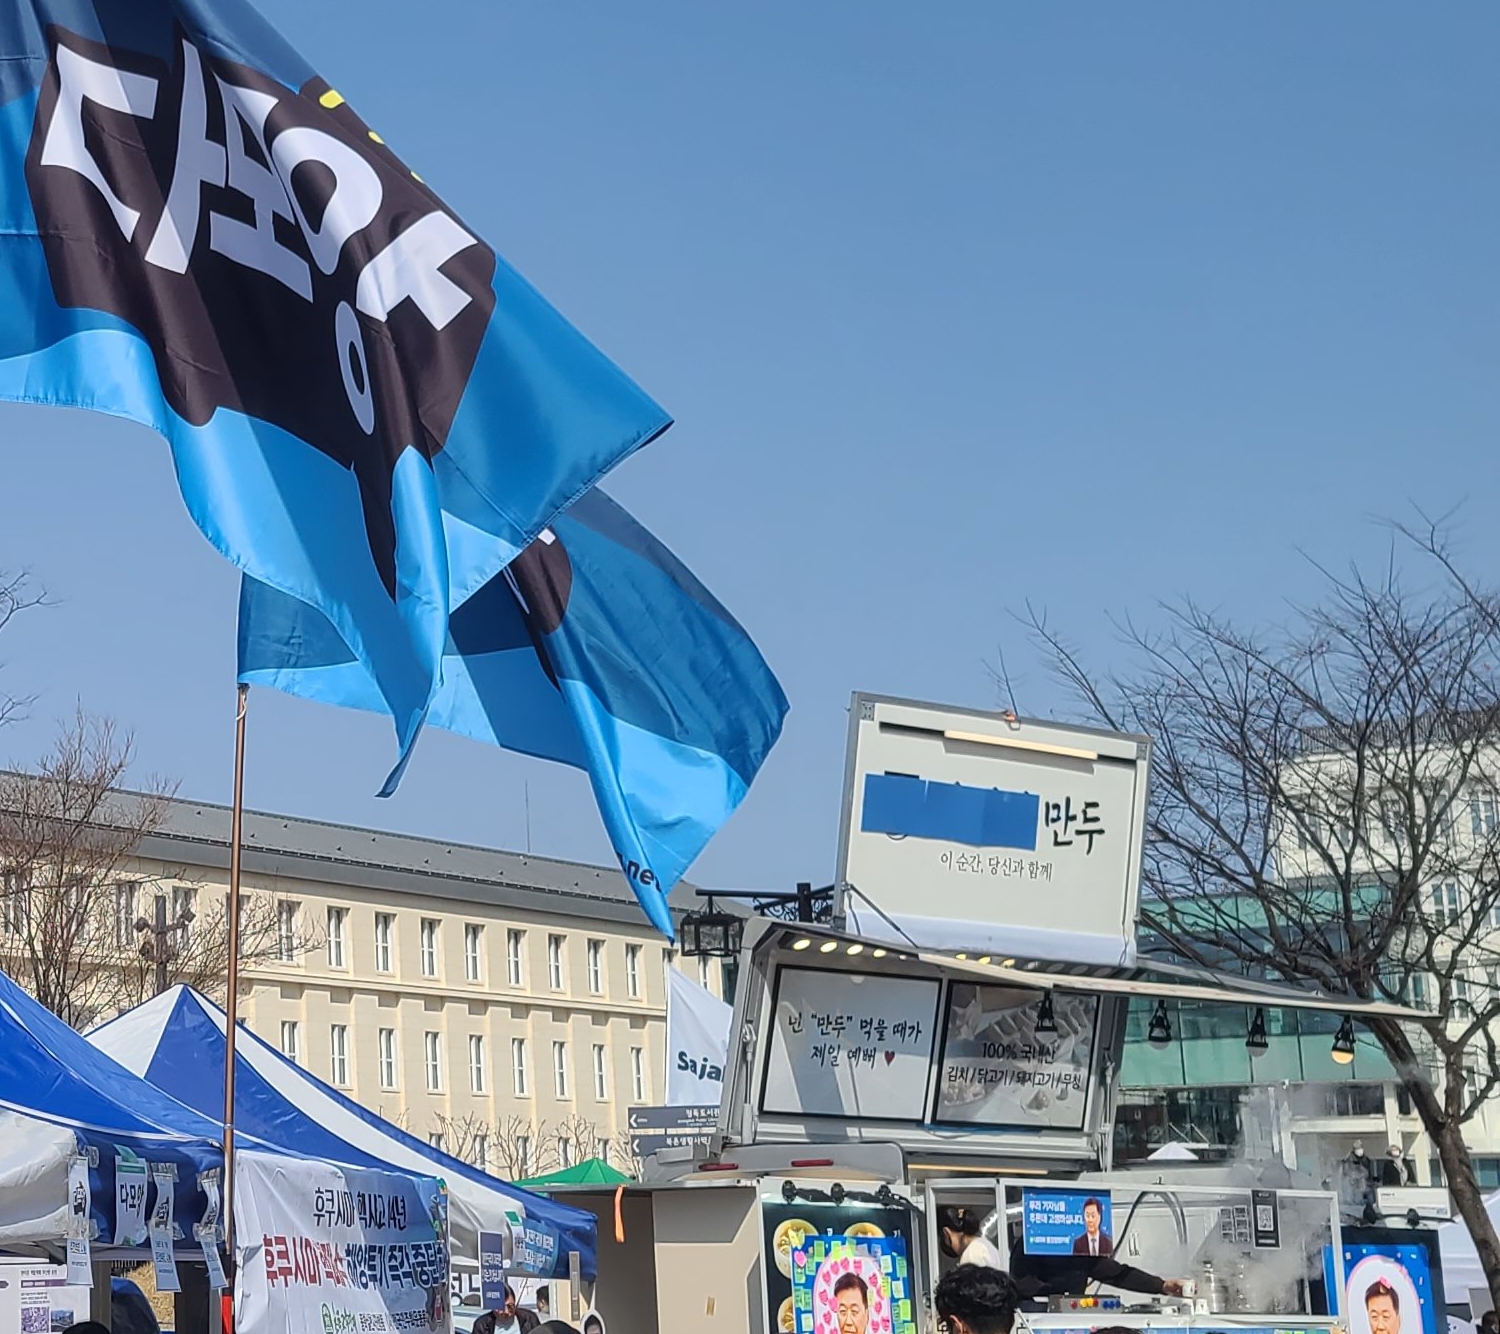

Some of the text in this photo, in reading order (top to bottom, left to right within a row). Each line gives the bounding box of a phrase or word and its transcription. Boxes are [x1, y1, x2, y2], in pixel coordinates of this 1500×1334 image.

[40, 37, 478, 436] 다모앙
[1044, 796, 1105, 855] 만두
[940, 851, 1053, 882] 이 순간, 당신과 함께
[859, 1017, 888, 1041] 먹을
[892, 1020, 922, 1044] 때가
[677, 1050, 725, 1083] Saja
[810, 1042, 877, 1070] 제일 예뻐
[982, 1042, 1059, 1065] 100% 국내산
[948, 1066, 969, 1083] 김치
[119, 1182, 144, 1219] 다모앙
[313, 1186, 356, 1228] 후쿠시마
[356, 1193, 386, 1230] 핵사고
[263, 1233, 322, 1288] 후쿠시마
[345, 1242, 390, 1291] 해양투기
[388, 1244, 412, 1290] 즉각
